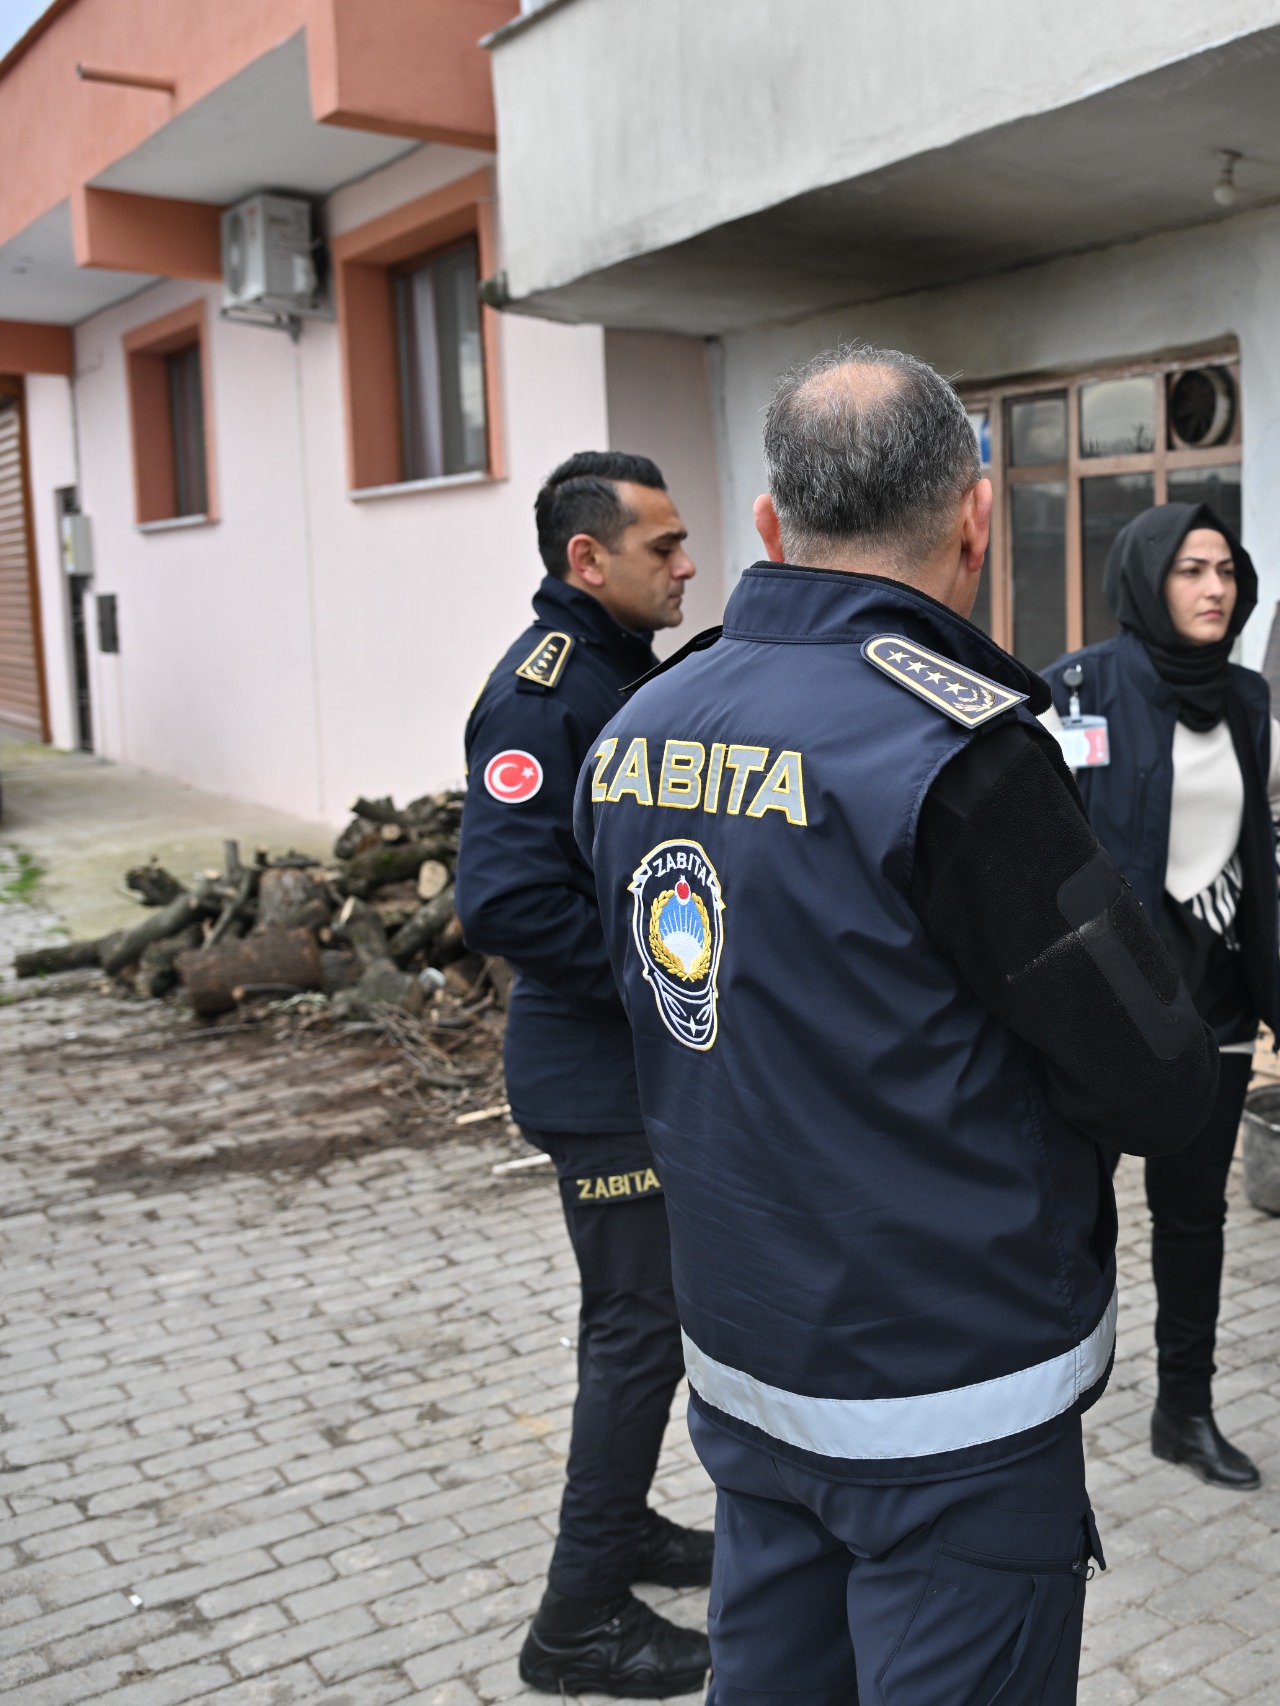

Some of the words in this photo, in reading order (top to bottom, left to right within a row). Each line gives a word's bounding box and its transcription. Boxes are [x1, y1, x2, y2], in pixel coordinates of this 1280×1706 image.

[592, 737, 807, 826] ZABITA
[653, 852, 707, 886] ZABITA
[576, 1168, 661, 1200] ZABITA
